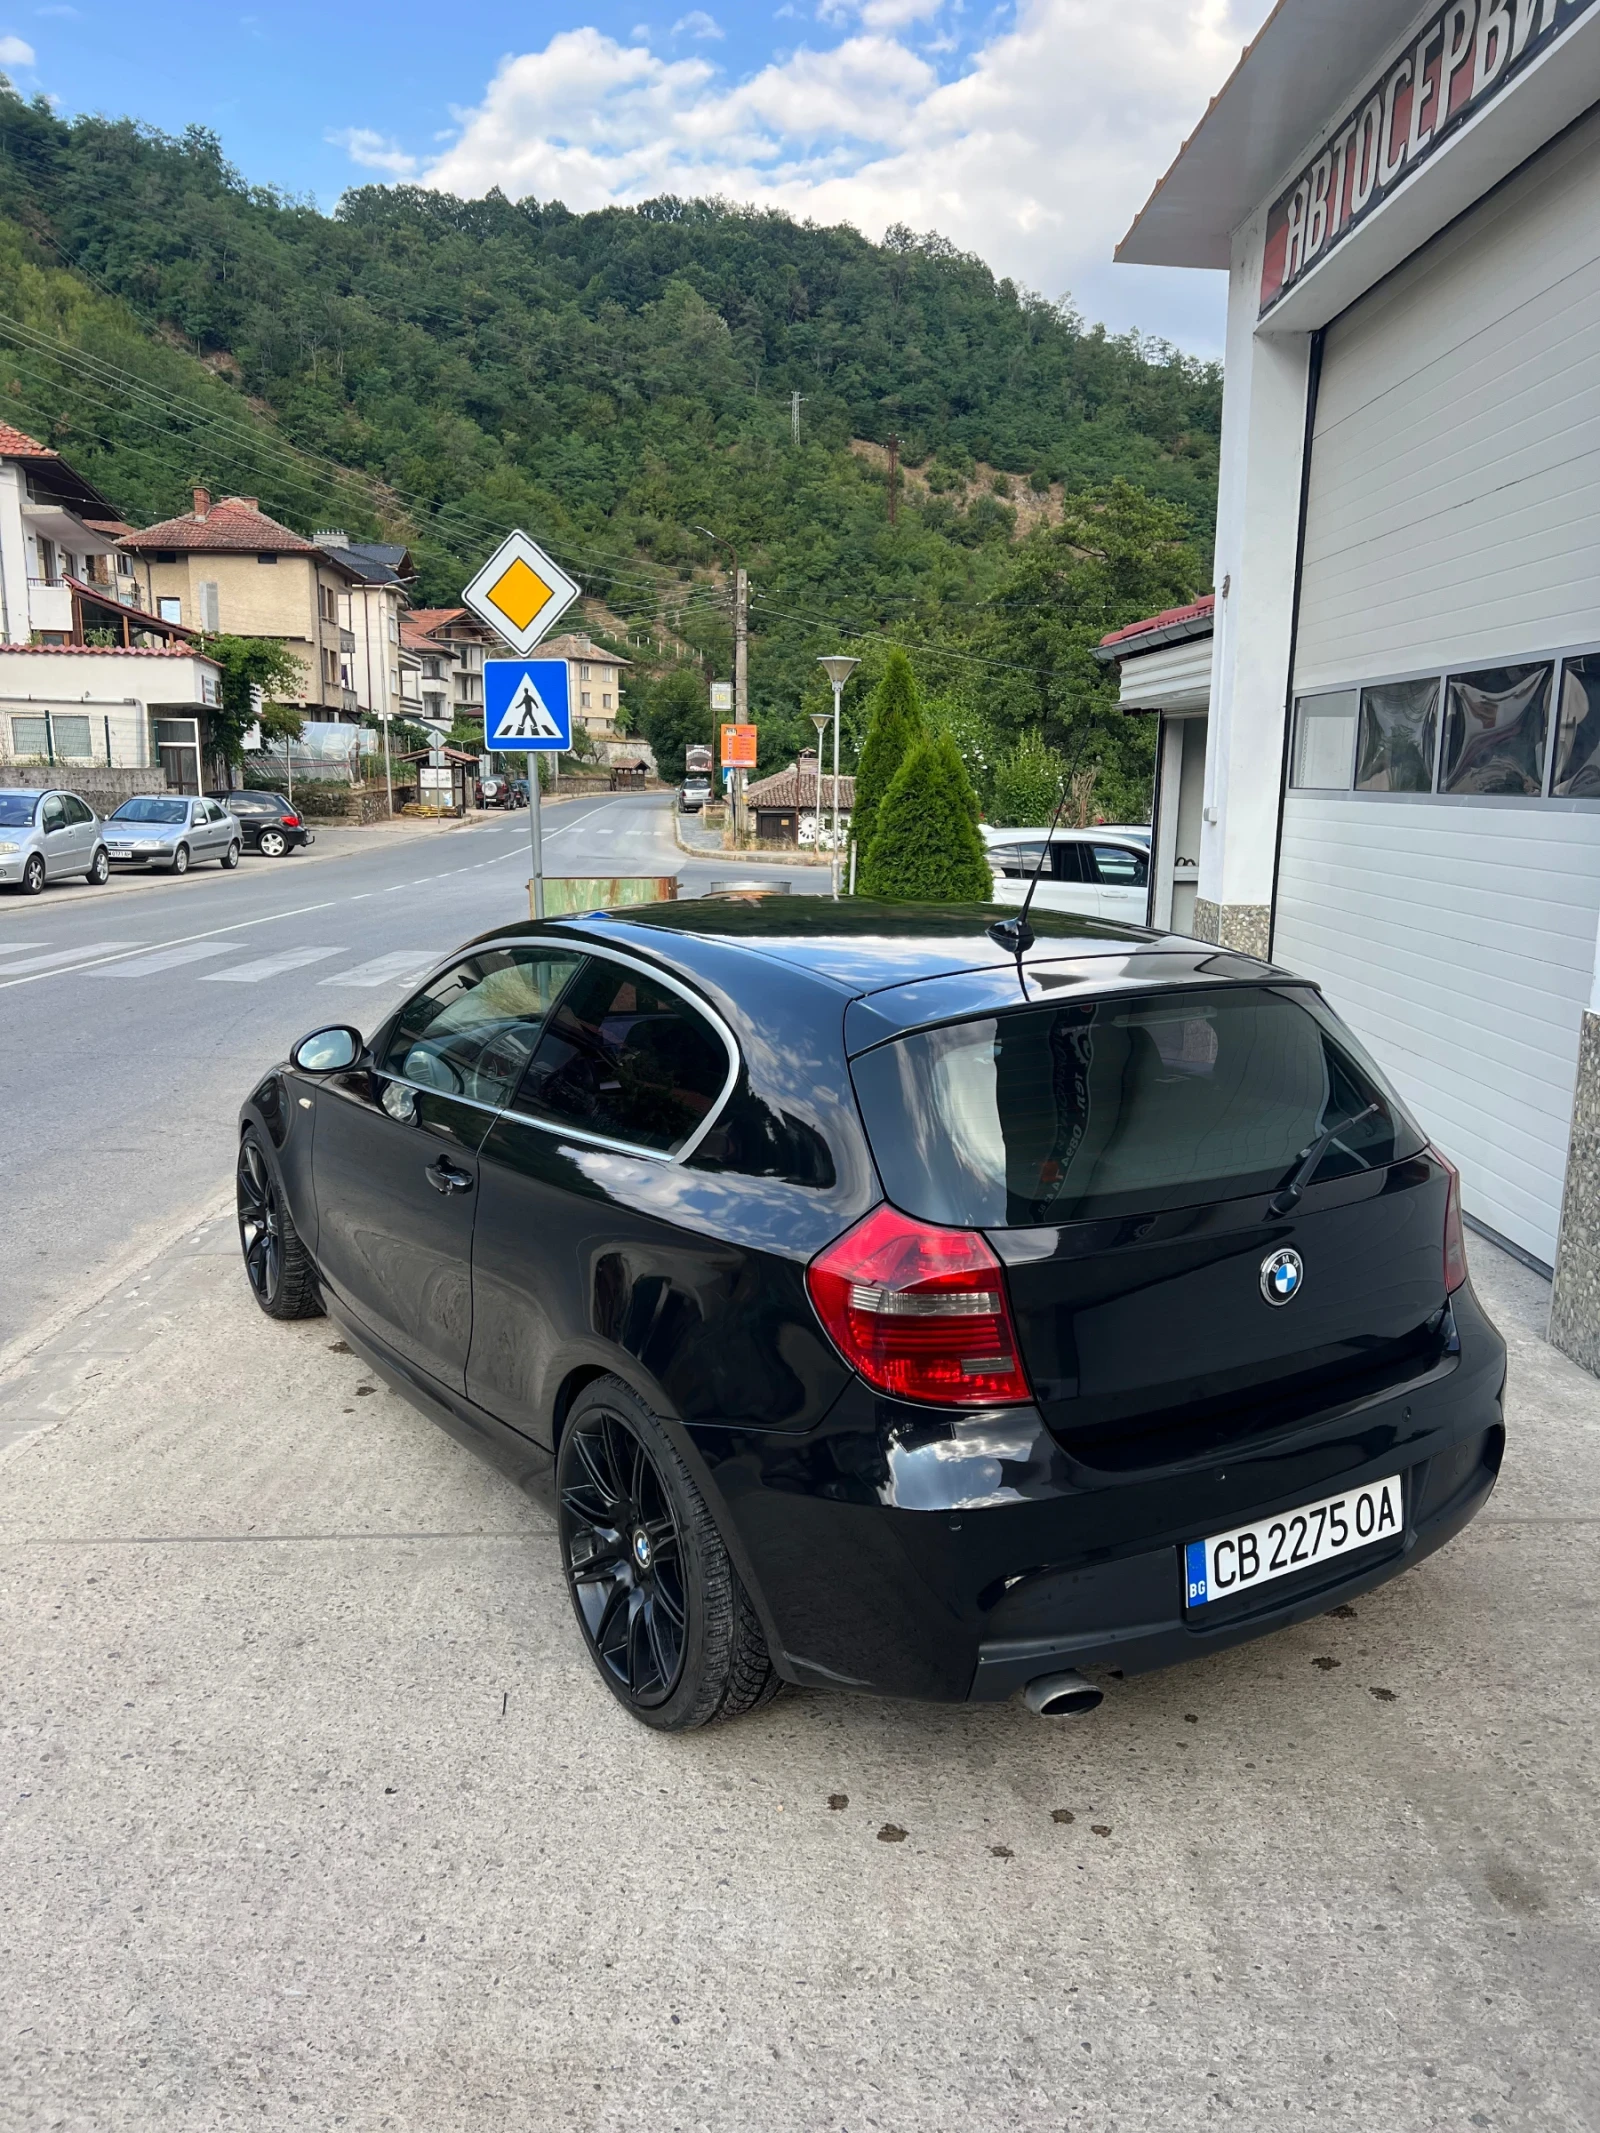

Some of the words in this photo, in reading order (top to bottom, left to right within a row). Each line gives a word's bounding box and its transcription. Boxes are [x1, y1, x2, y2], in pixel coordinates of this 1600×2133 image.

[1271, 1254, 1300, 1274] BMW
[1213, 1532, 1260, 1589] CB
[1267, 1500, 1348, 1572] 2275
[1356, 1486, 1396, 1538] OA
[1189, 1580, 1206, 1599] BG
